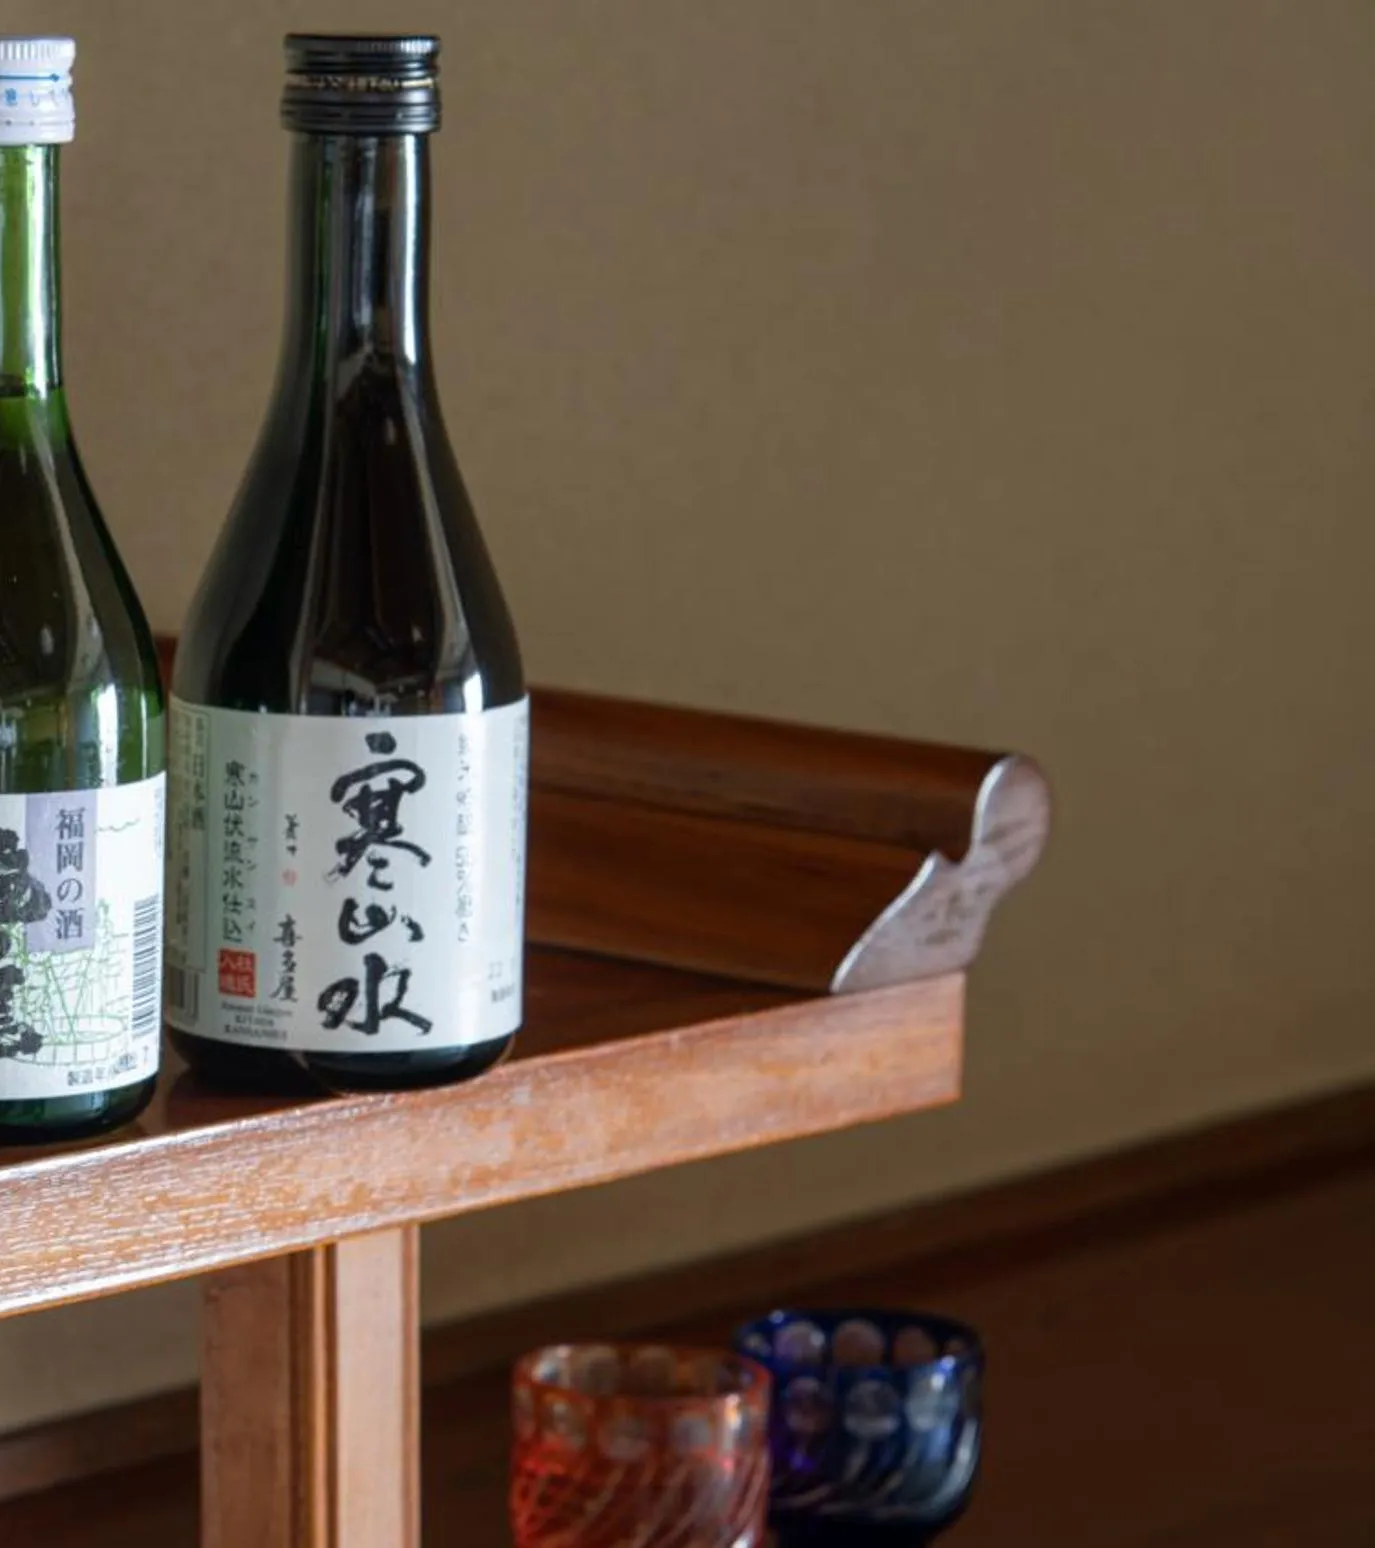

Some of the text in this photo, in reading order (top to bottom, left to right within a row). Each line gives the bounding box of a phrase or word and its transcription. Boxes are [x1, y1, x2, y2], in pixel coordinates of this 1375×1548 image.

[55, 807, 86, 940] 福岡の酒
[317, 731, 433, 1037] 寒山水
[268, 912, 304, 1003] 喜多屋
